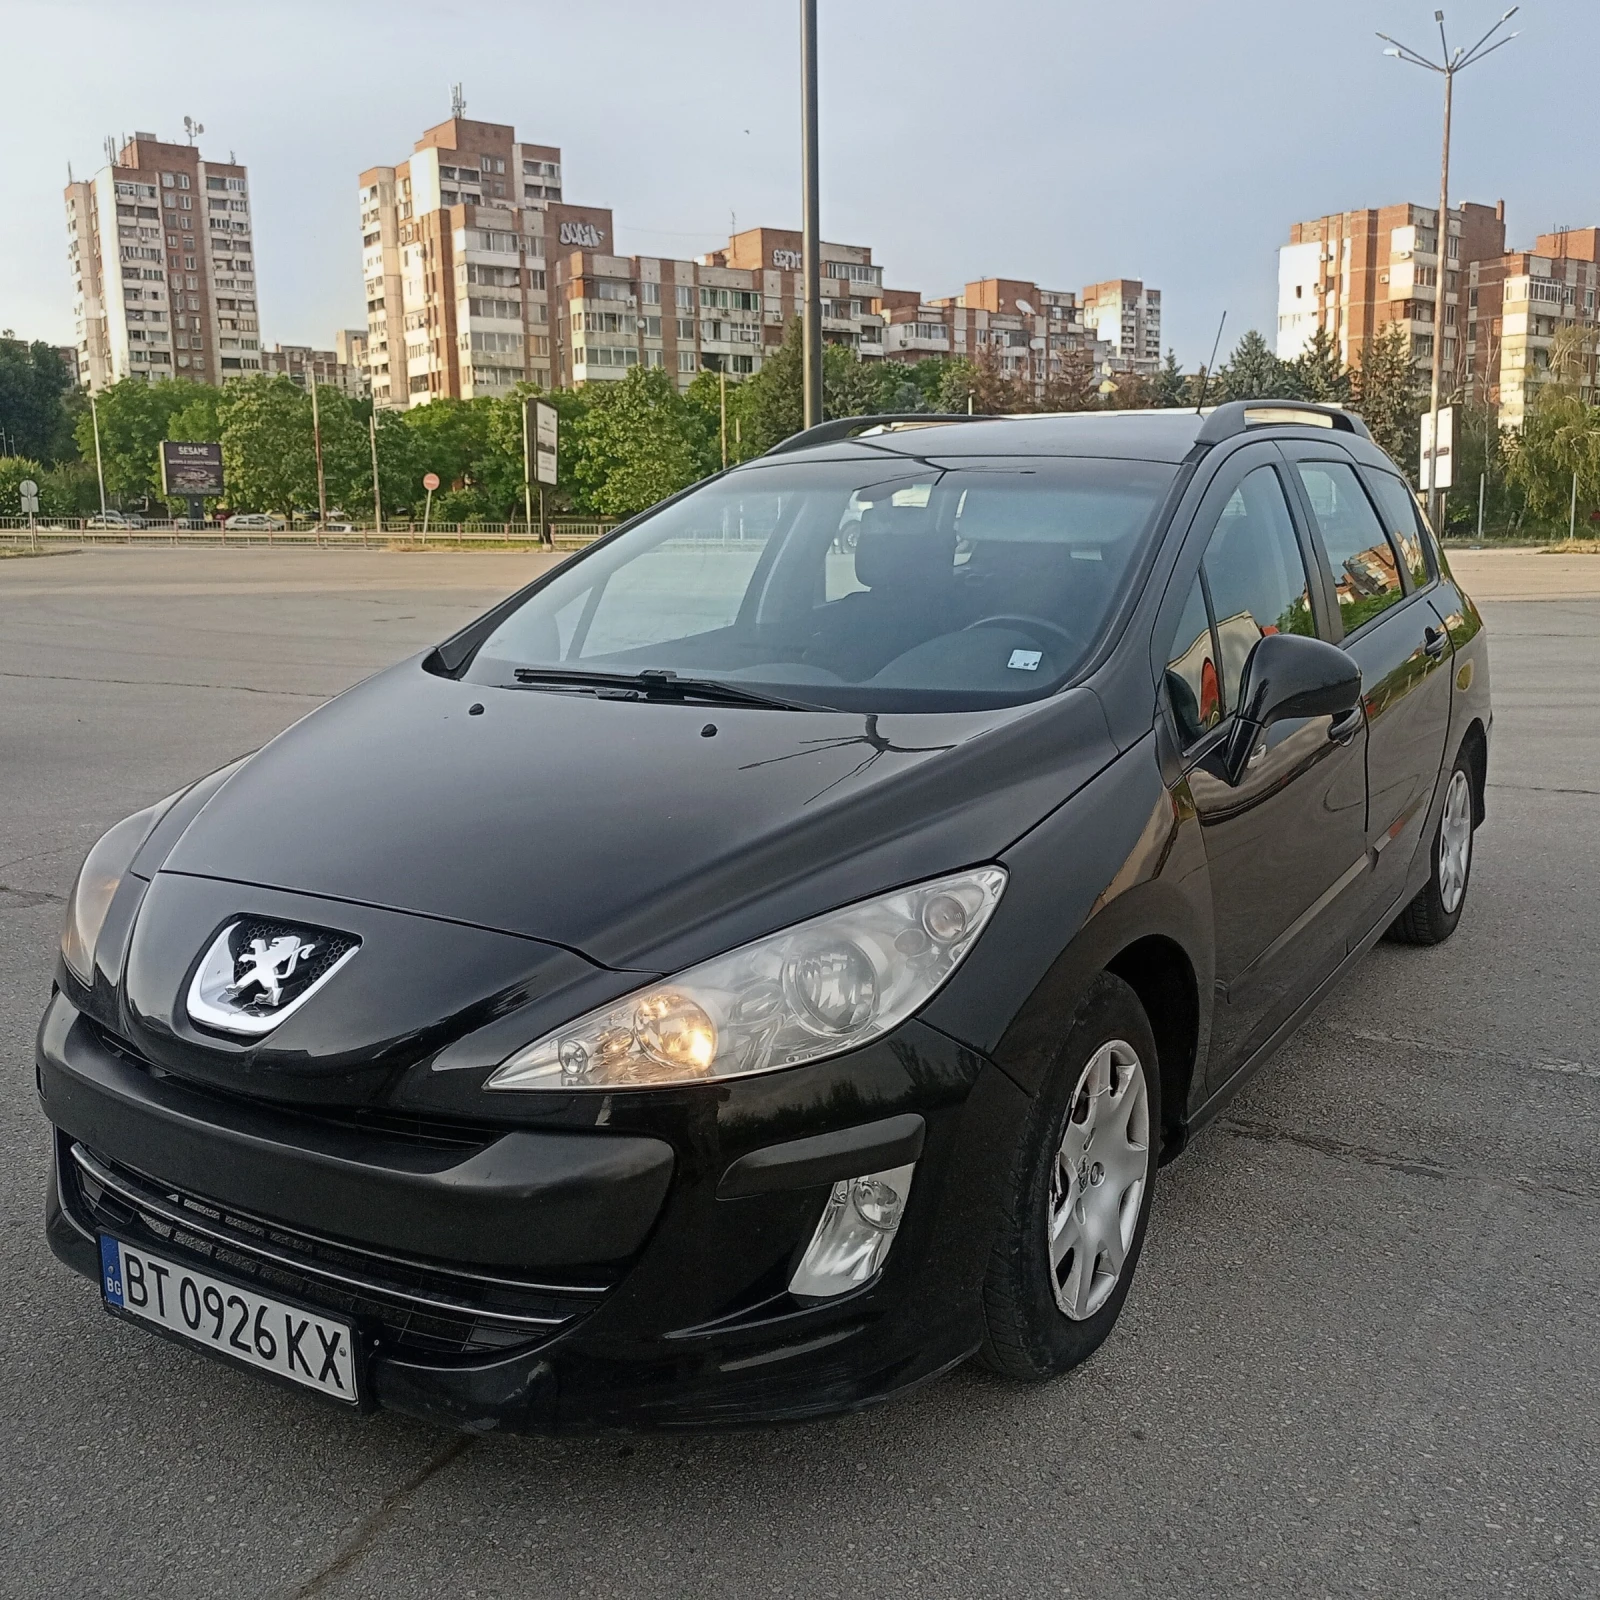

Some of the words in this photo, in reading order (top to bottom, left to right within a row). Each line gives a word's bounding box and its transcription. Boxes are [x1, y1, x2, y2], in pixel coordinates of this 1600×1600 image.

[178, 446, 208, 456] SESAME
[107, 1276, 122, 1296] BG
[124, 1252, 170, 1318] BT
[180, 1276, 277, 1360] 0926
[285, 1313, 345, 1390] KX
